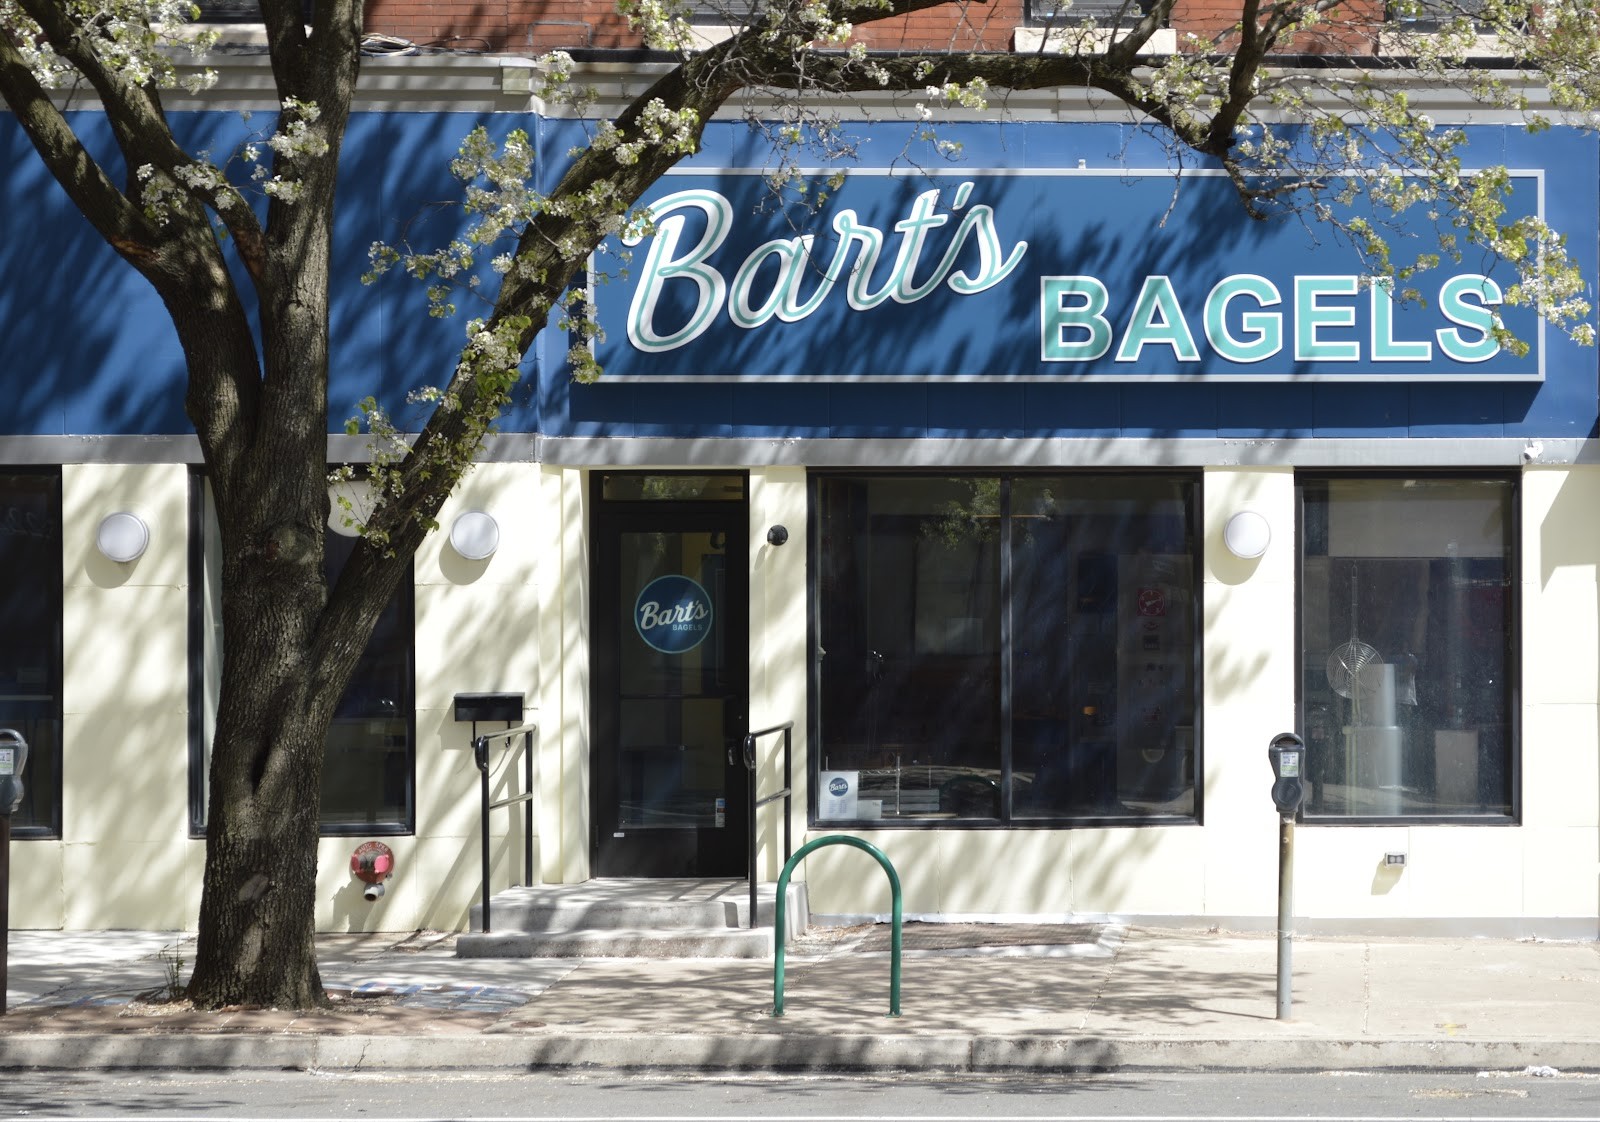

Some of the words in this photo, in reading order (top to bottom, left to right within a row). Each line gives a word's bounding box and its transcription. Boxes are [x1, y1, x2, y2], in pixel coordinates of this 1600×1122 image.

[621, 182, 1028, 353] Bart's
[1040, 274, 1504, 363] BAGELS
[640, 600, 708, 630] Bart's
